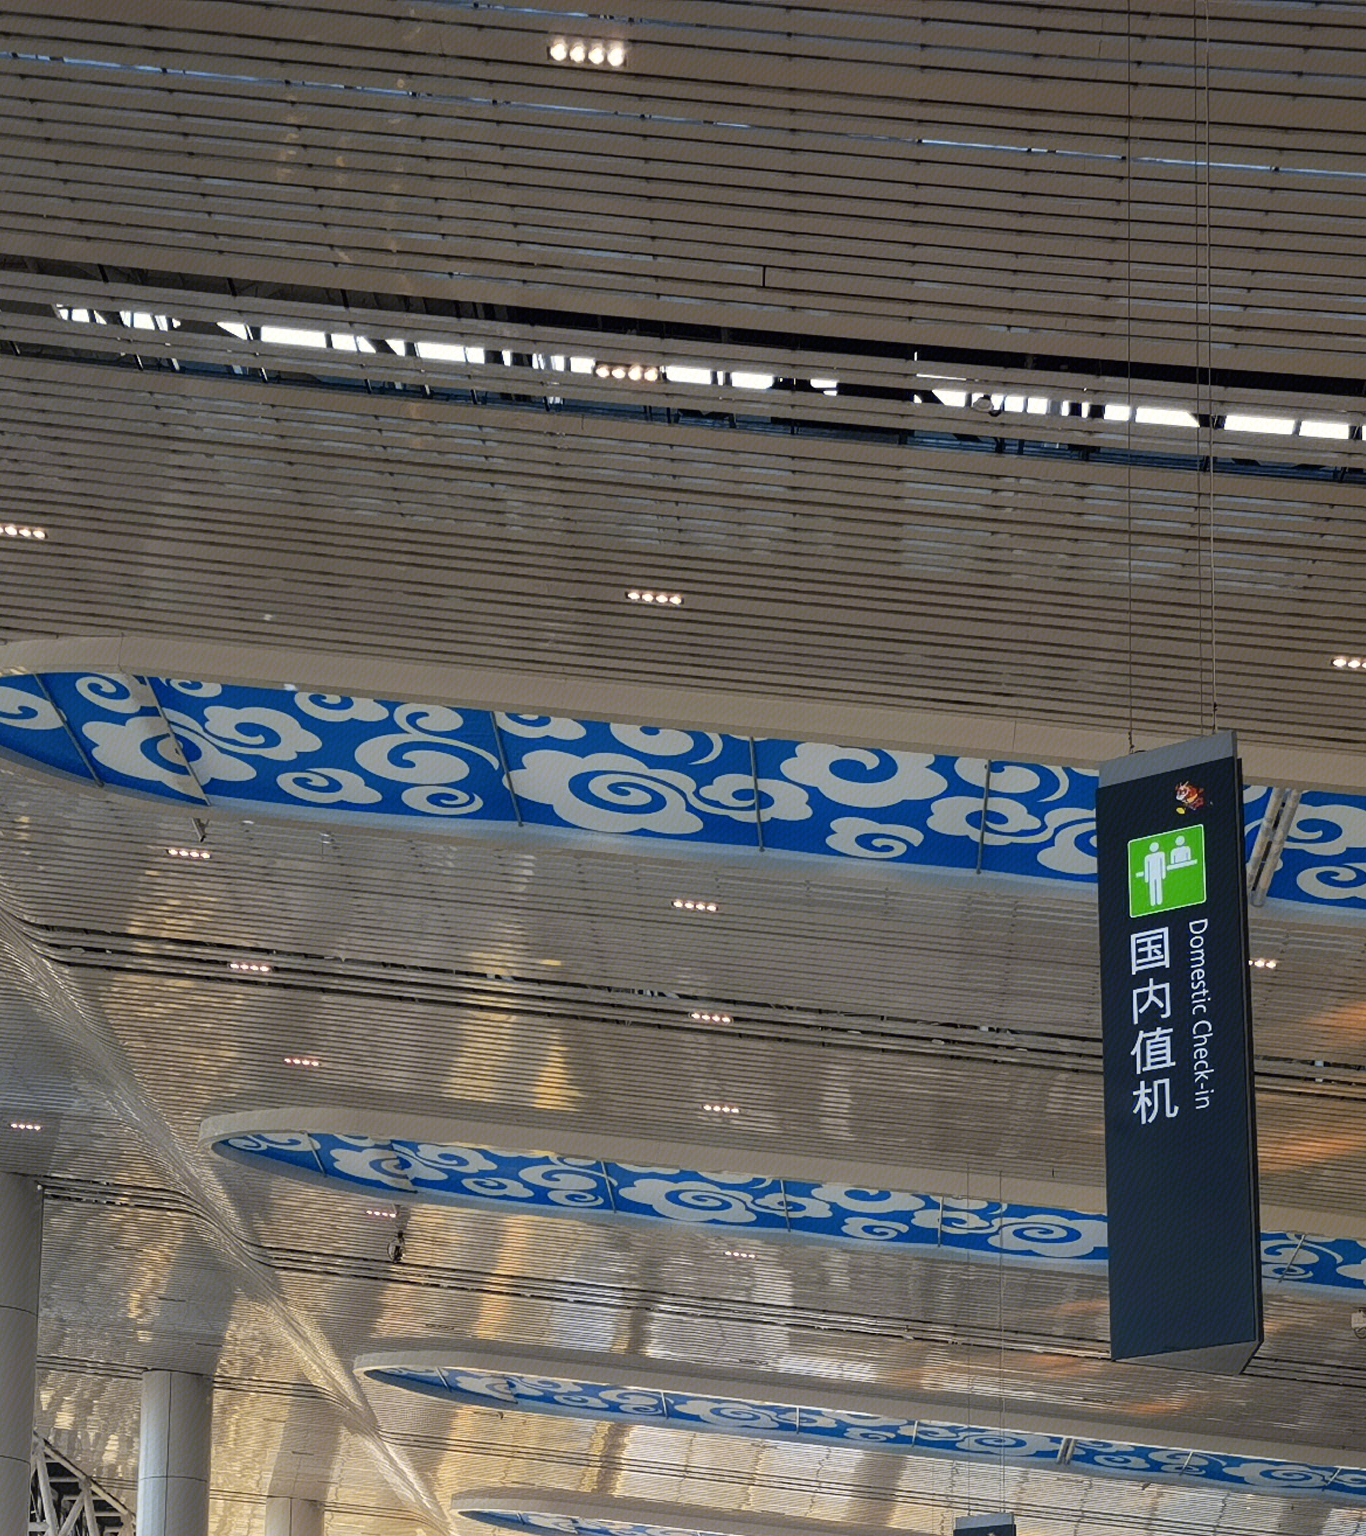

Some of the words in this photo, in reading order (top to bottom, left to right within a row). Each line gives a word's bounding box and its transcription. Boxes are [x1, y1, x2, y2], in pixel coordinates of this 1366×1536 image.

[1188, 918, 1210, 1015] Domestic
[1130, 926, 1179, 1125] 国内值机
[1193, 1020, 1214, 1110] Check-in
